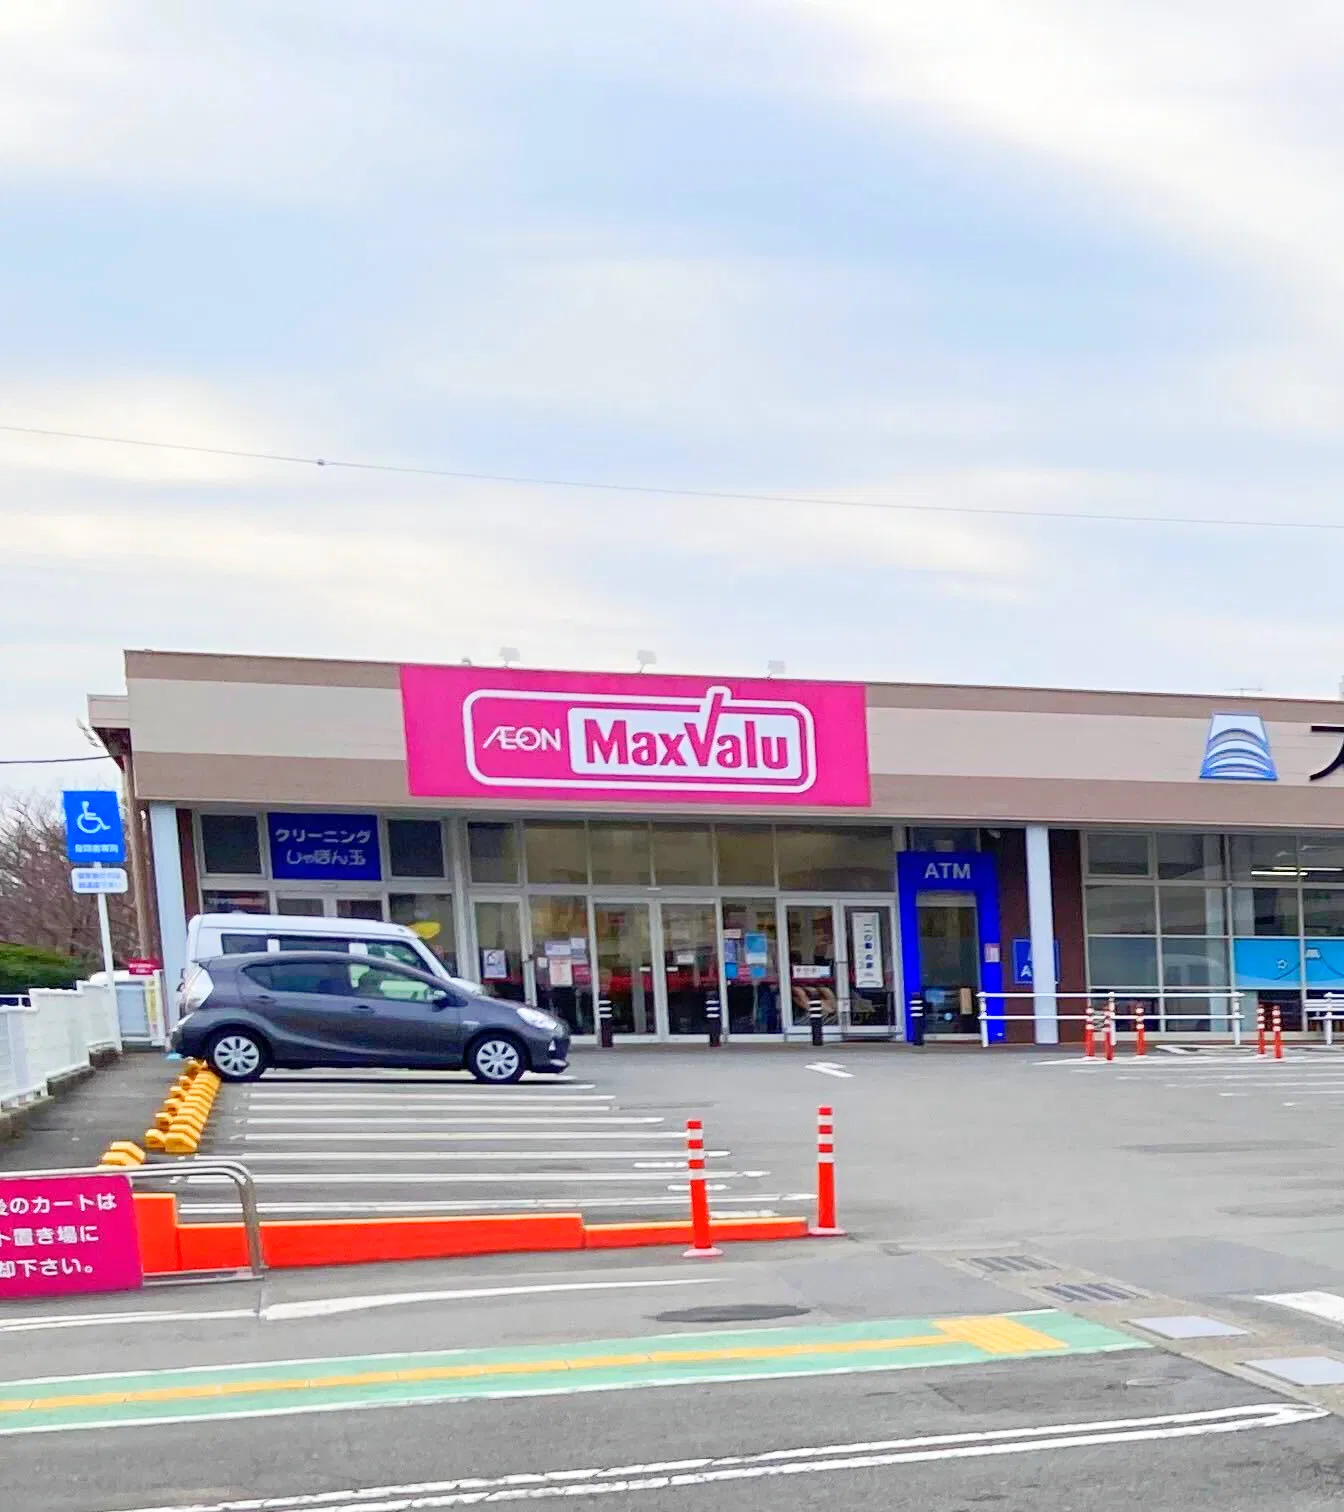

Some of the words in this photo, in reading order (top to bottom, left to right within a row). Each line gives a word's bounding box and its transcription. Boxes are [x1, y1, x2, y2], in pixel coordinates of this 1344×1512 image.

[585, 693, 789, 770] MaxValu
[275, 828, 371, 844] クリーニング
[924, 862, 971, 880] ATM
